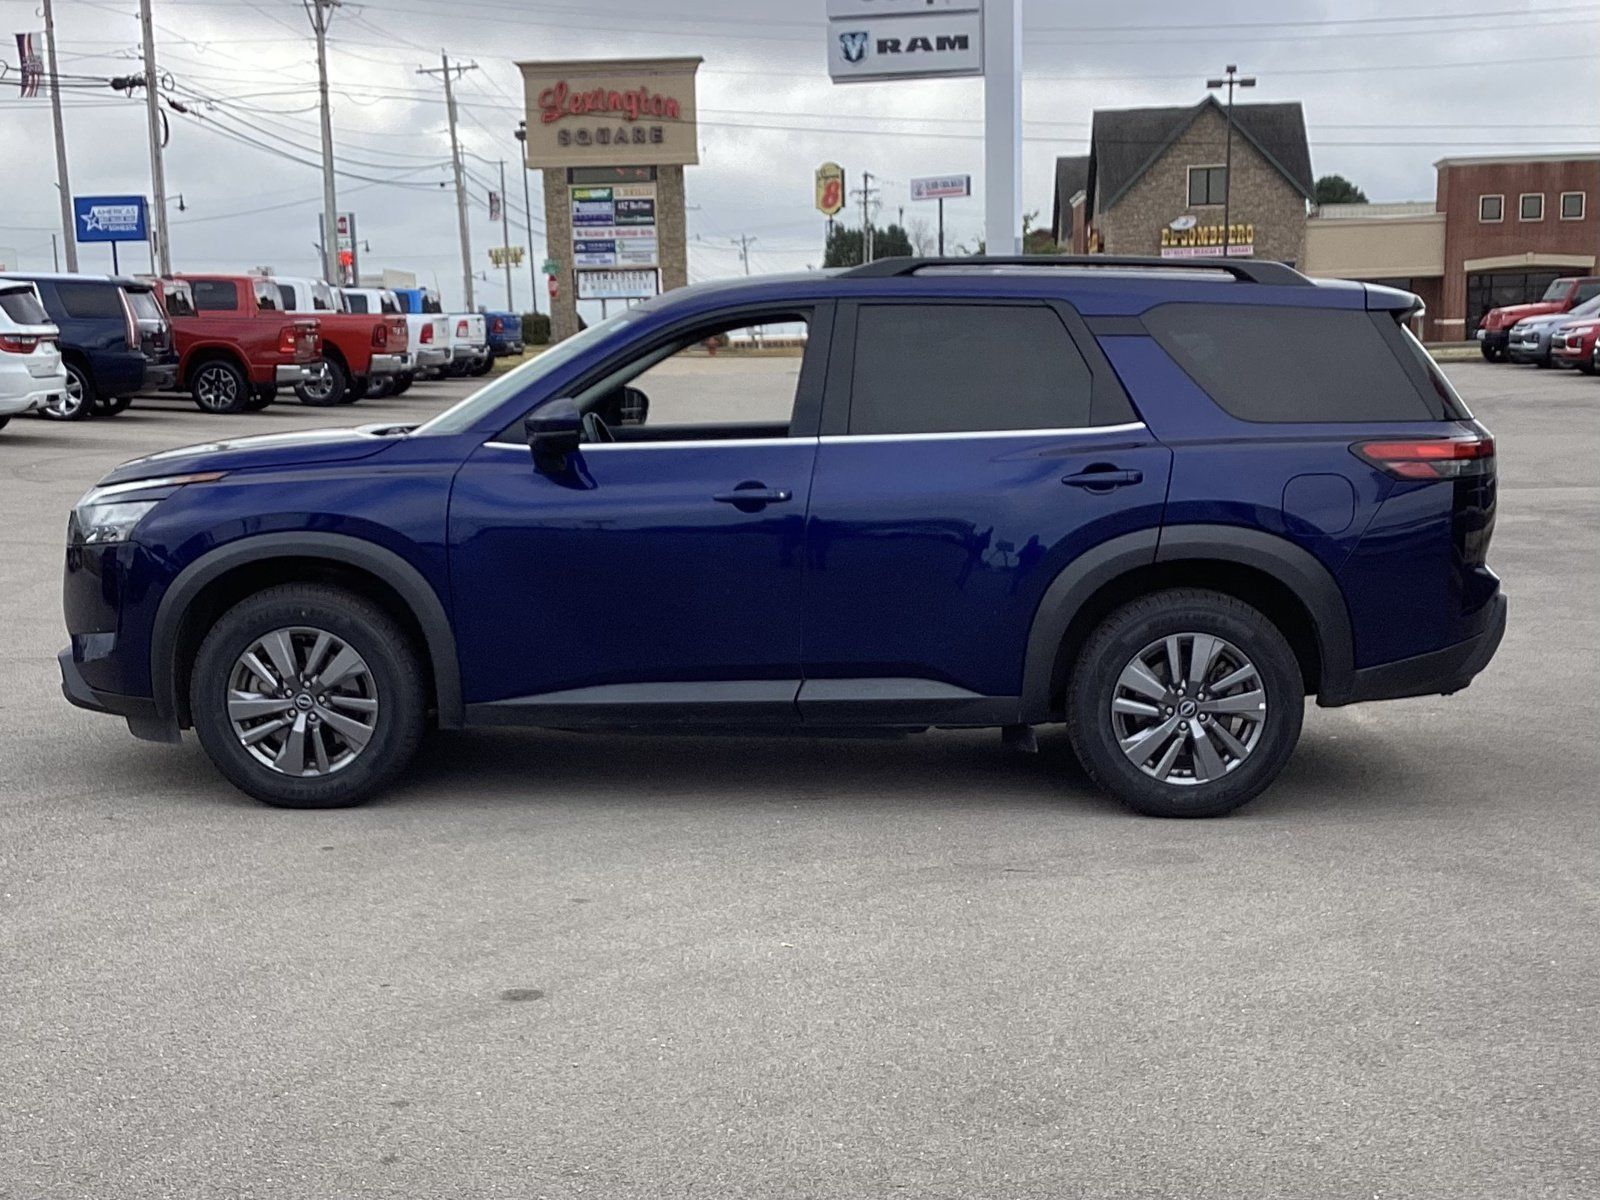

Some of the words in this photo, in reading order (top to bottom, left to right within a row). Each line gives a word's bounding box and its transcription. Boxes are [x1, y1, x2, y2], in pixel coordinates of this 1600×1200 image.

[877, 35, 968, 54] RAM
[538, 81, 679, 123] Lexington
[558, 127, 663, 146] SQUARE
[821, 181, 840, 209] 8
